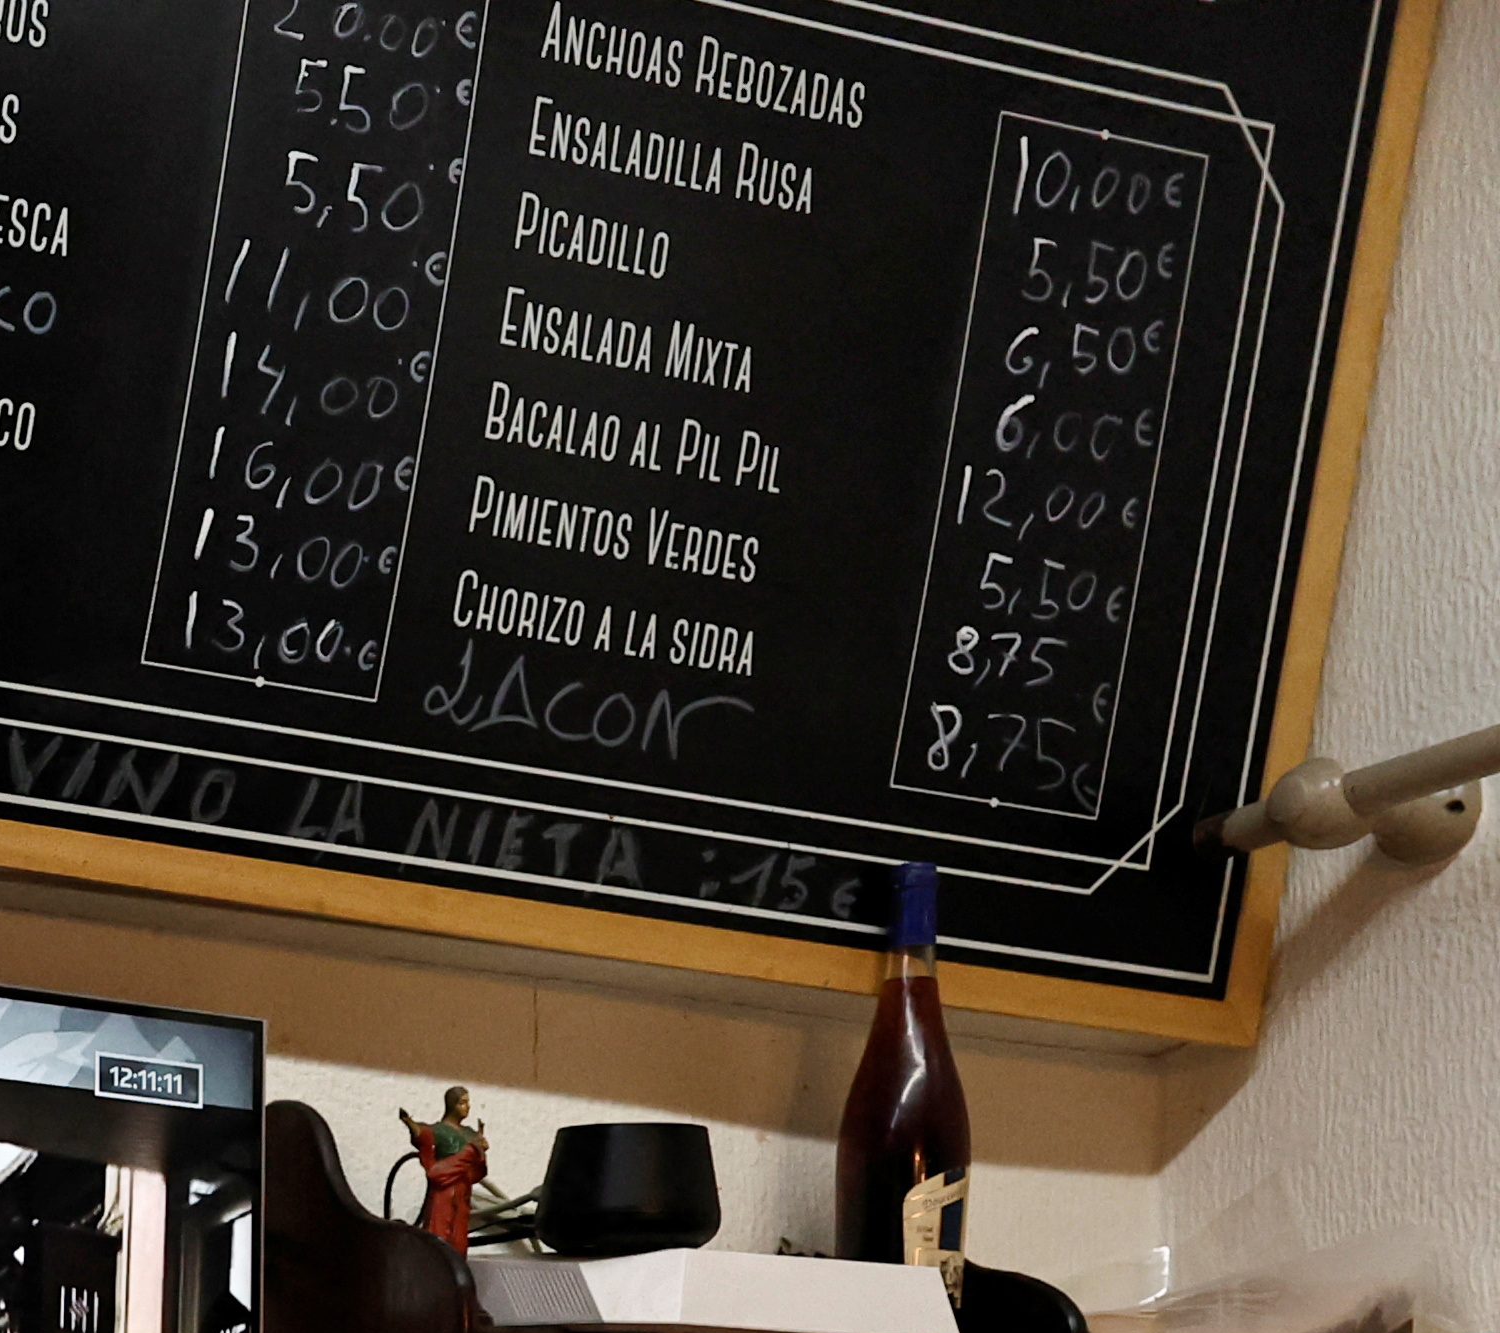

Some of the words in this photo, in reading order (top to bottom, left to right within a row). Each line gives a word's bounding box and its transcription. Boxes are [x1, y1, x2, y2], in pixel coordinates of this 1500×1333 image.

[541, 1, 683, 87] ANCHOAS
[695, 36, 865, 128] REBOZADAS
[529, 96, 721, 194] ENSALADILLA
[736, 142, 811, 214] RUSA
[515, 192, 669, 278] PICADILLO
[500, 287, 651, 372] ENSALADA
[665, 321, 751, 392] MIXTA
[485, 382, 620, 461] BACALAO
[630, 422, 660, 470] AL
[676, 419, 720, 482] PIL
[736, 431, 779, 493] PIL
[469, 476, 632, 559] PIMIENTOS
[649, 508, 758, 582] VERDES
[454, 570, 584, 646] CHORIZO
[594, 606, 611, 651] A
[625, 611, 656, 659] LA
[670, 619, 753, 676] SIDRA
[109, 1066, 183, 1094] 12:11:11
